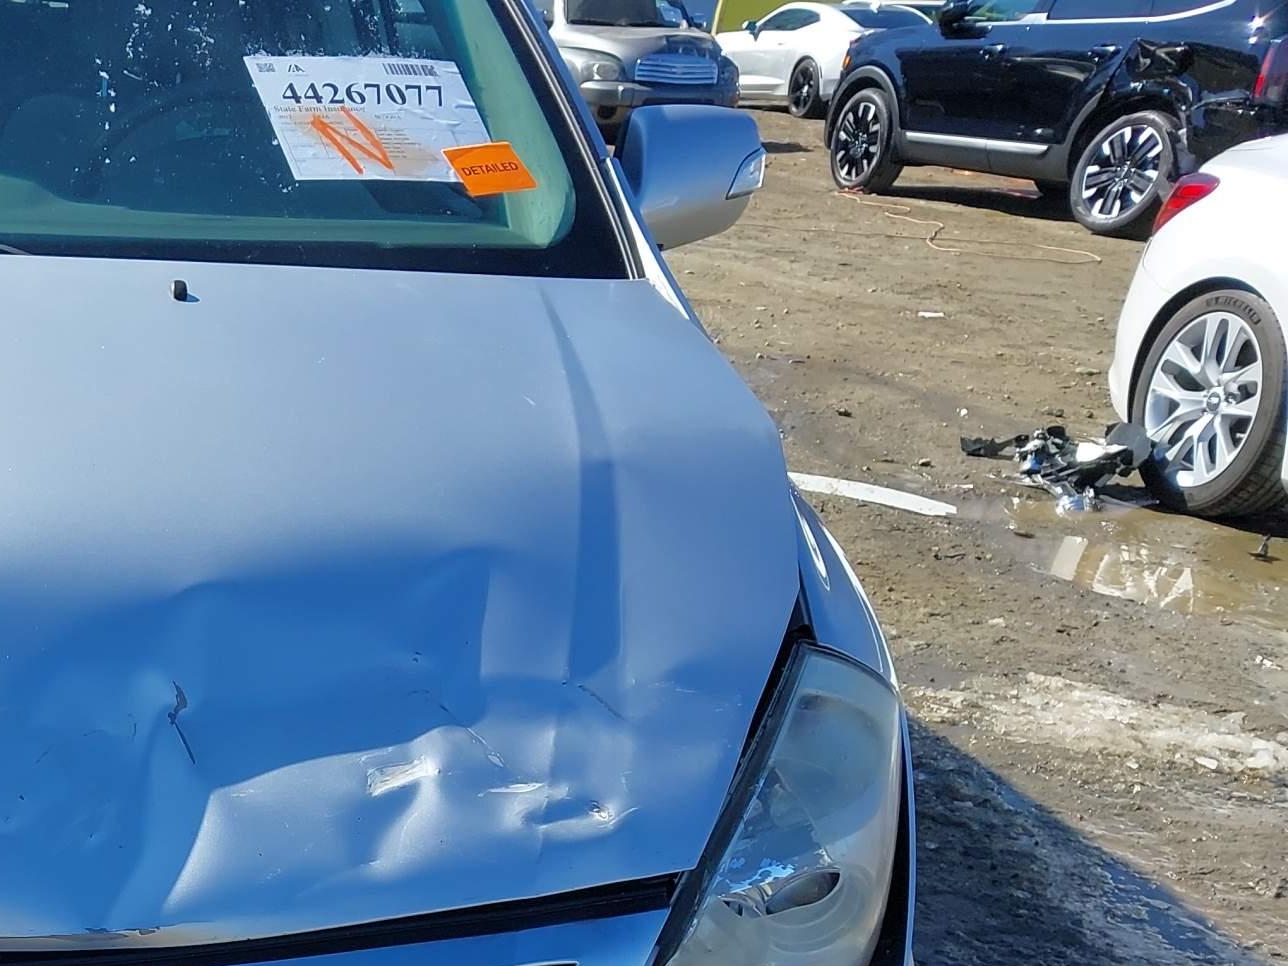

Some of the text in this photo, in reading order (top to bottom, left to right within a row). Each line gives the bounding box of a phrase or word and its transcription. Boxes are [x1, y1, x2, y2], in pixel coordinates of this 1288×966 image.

[282, 82, 443, 107] 44267077
[273, 105, 297, 113] State
[298, 105, 323, 113] Farm
[461, 161, 519, 177] DETAILED
